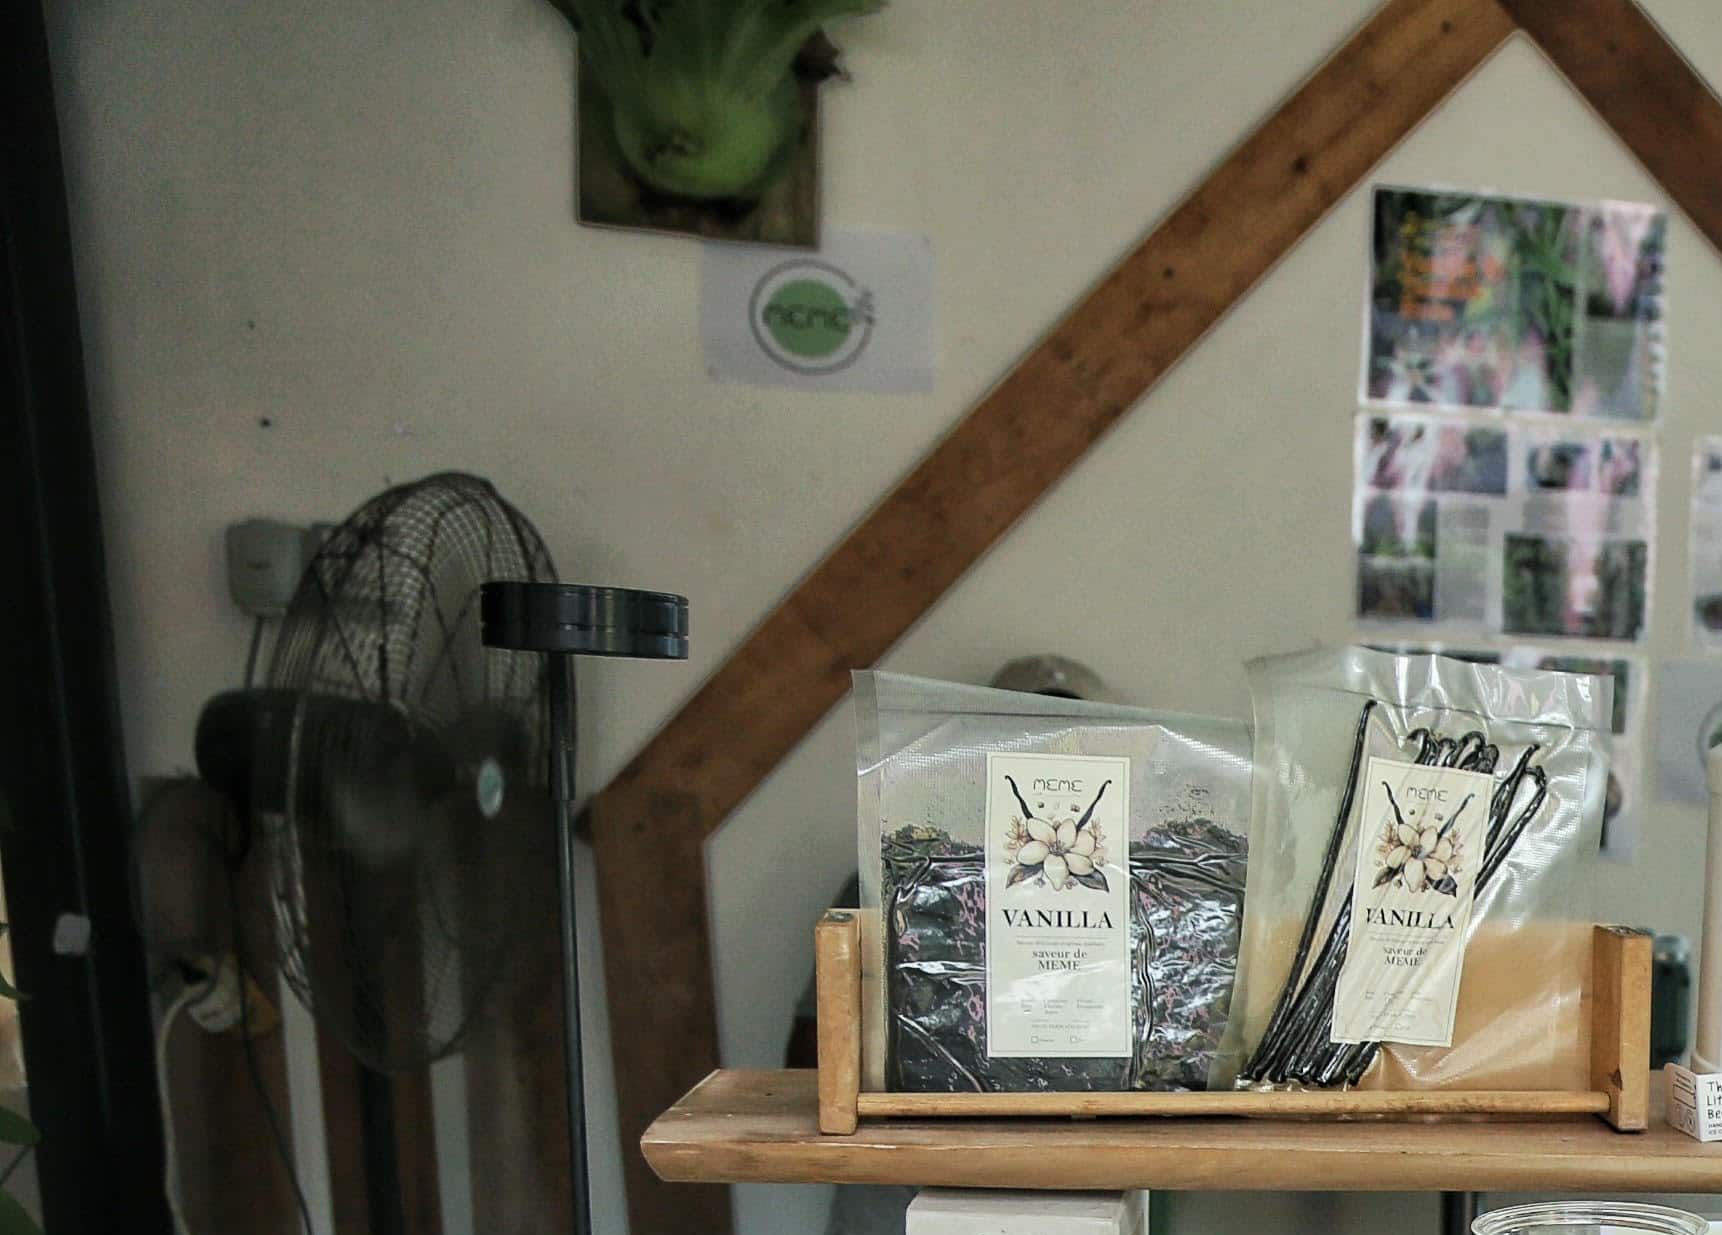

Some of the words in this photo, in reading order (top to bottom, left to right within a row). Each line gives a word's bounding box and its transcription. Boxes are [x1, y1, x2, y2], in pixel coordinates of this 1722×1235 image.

[1002, 908, 1114, 928] VANILLA
[1366, 907, 1455, 929] VANILLA
[1032, 951, 1071, 959] saveur
[1073, 948, 1088, 959] de
[1038, 960, 1081, 970] MEME
